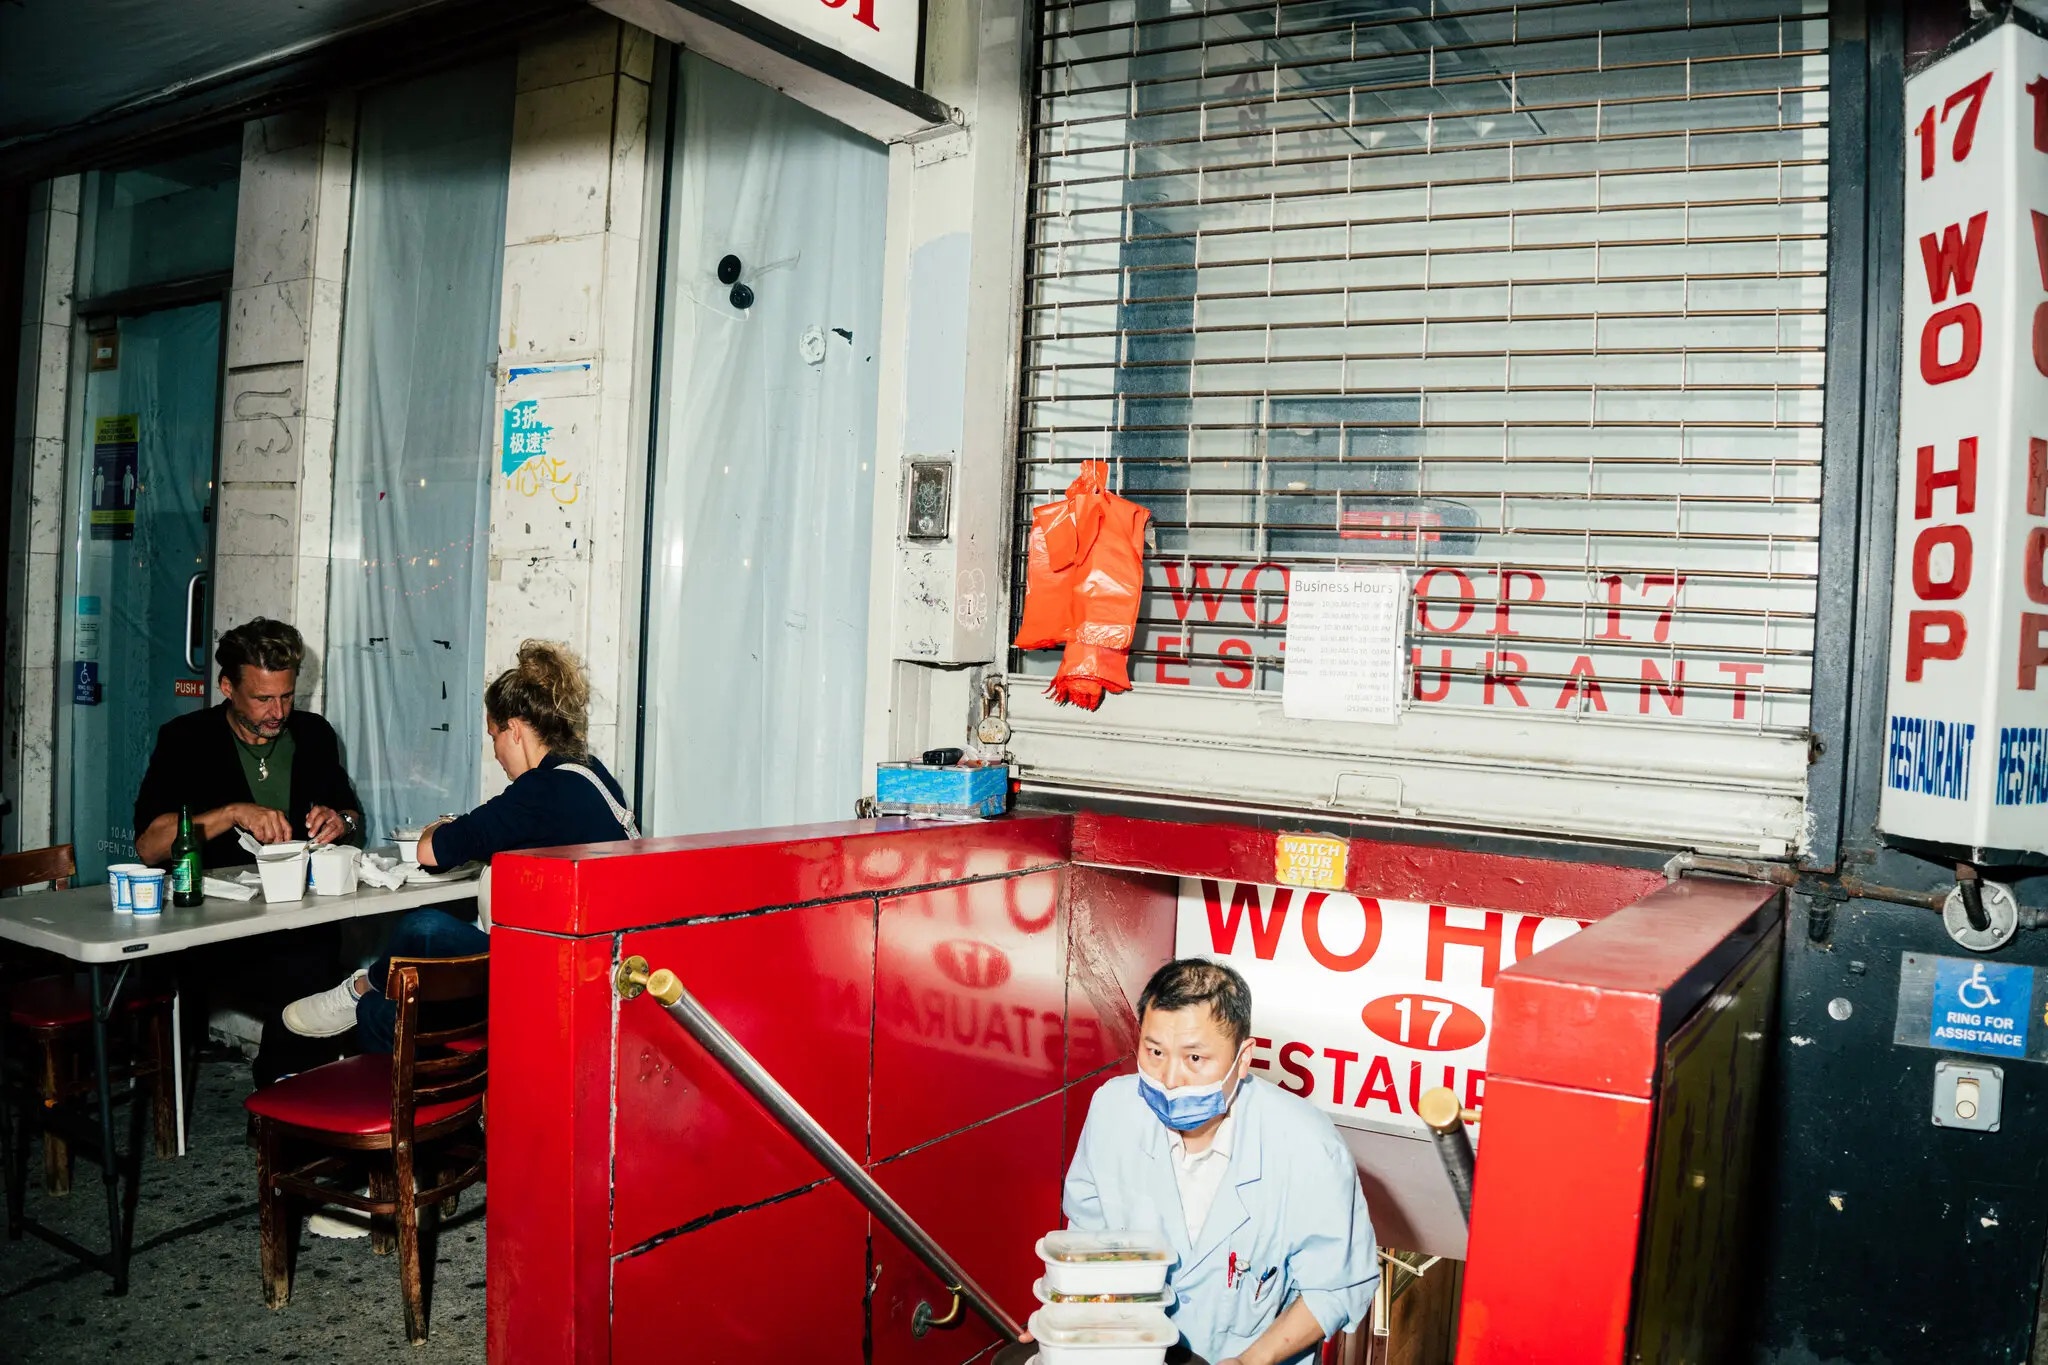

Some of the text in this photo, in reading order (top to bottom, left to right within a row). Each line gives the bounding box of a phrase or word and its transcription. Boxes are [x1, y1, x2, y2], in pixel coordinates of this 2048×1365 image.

[1914, 71, 1994, 181] 17
[2024, 73, 2048, 155] 1
[1919, 210, 1989, 385] WO
[511, 405, 549, 430] 3折
[509, 431, 551, 454] 极速
[1905, 435, 1979, 683] HOP
[1160, 561, 1687, 643] WO OP 17
[1295, 579, 1393, 594] Business Hours
[175, 681, 197, 695] PUSH
[1154, 636, 1765, 721] ESURANT
[1887, 715, 1976, 802] RESTAURANT
[1996, 727, 2048, 806] RESTAU
[97, 839, 139, 859] OPEN 7 DA
[1284, 841, 1341, 857] WATCH
[1289, 853, 1333, 868] YOUR
[1289, 866, 1334, 881] STEP!
[1200, 879, 1383, 973] WO
[1394, 997, 1454, 1047] 17
[1935, 1026, 2023, 1047] ASSISTANCE
[1946, 1011, 2014, 1030] RING FOR
